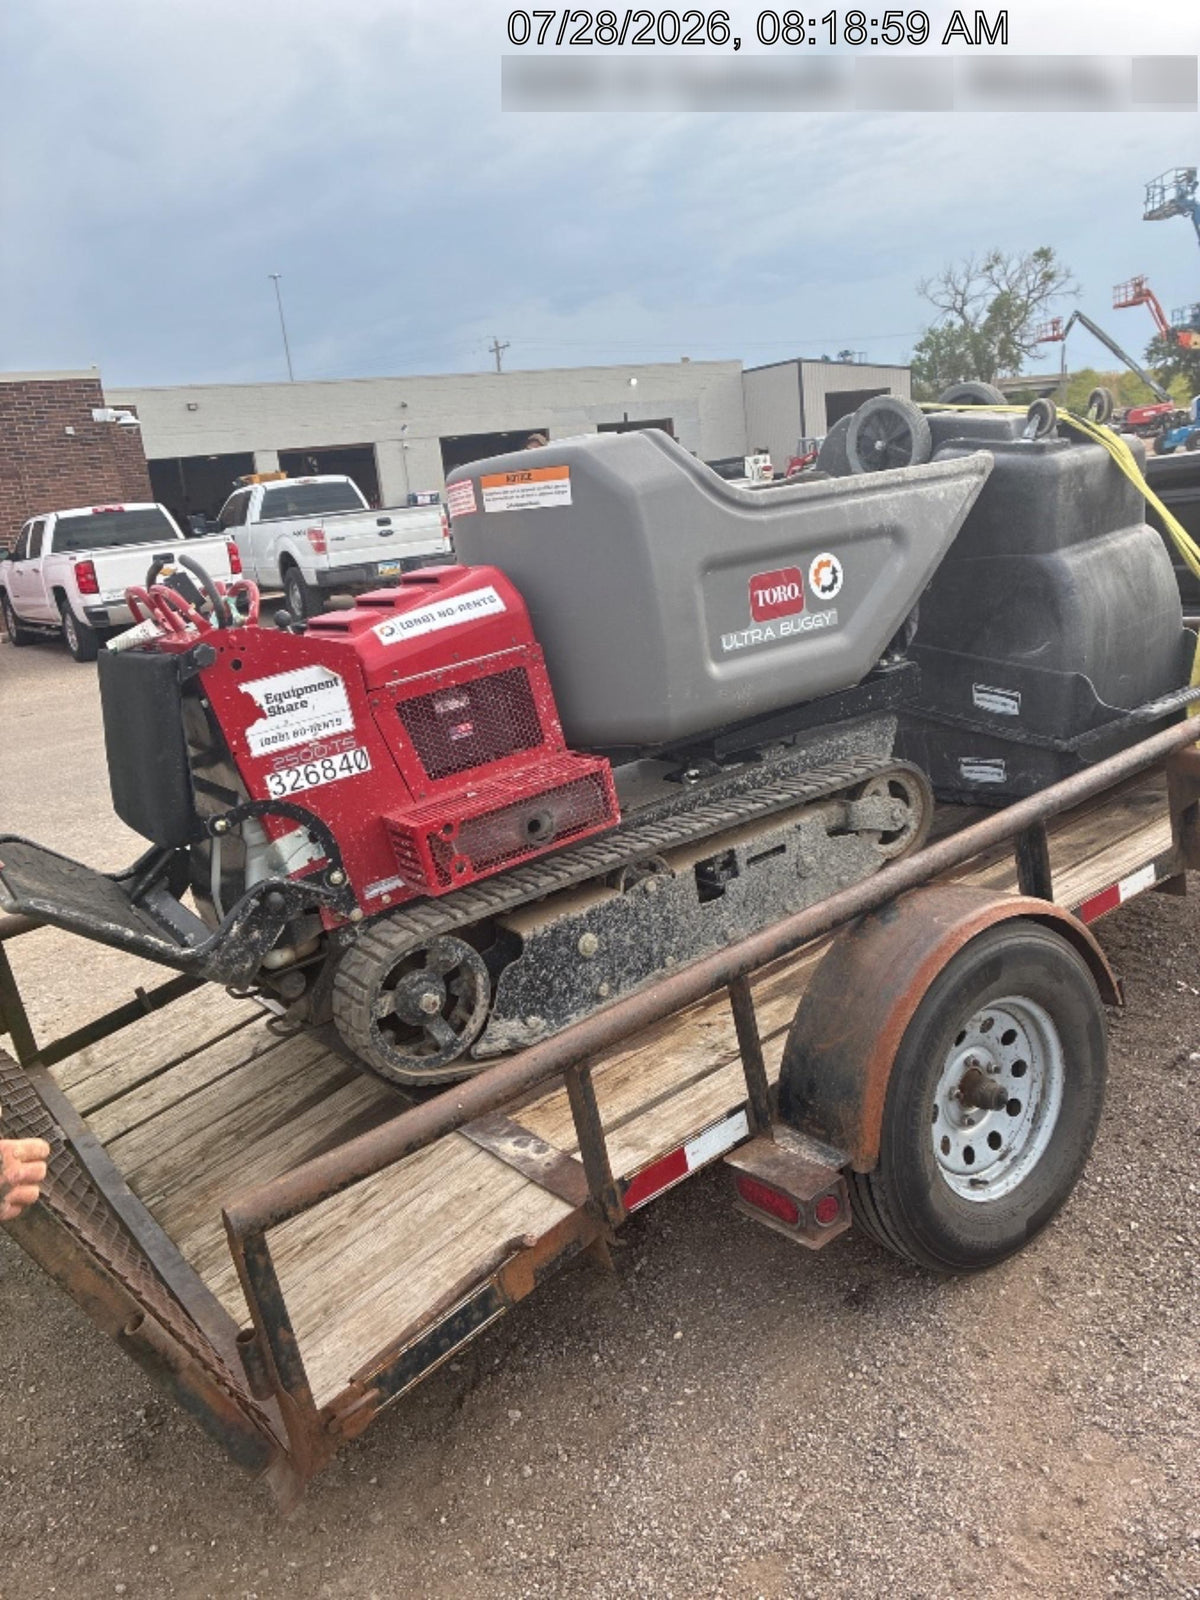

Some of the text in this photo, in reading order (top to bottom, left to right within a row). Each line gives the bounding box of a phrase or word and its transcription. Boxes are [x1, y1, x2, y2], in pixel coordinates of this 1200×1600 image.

[754, 582, 800, 608] TORO
[720, 611, 833, 651] ULTRA BUGGY
[264, 677, 340, 705] Equipment
[267, 699, 309, 717] Share
[269, 748, 369, 796] 326840
